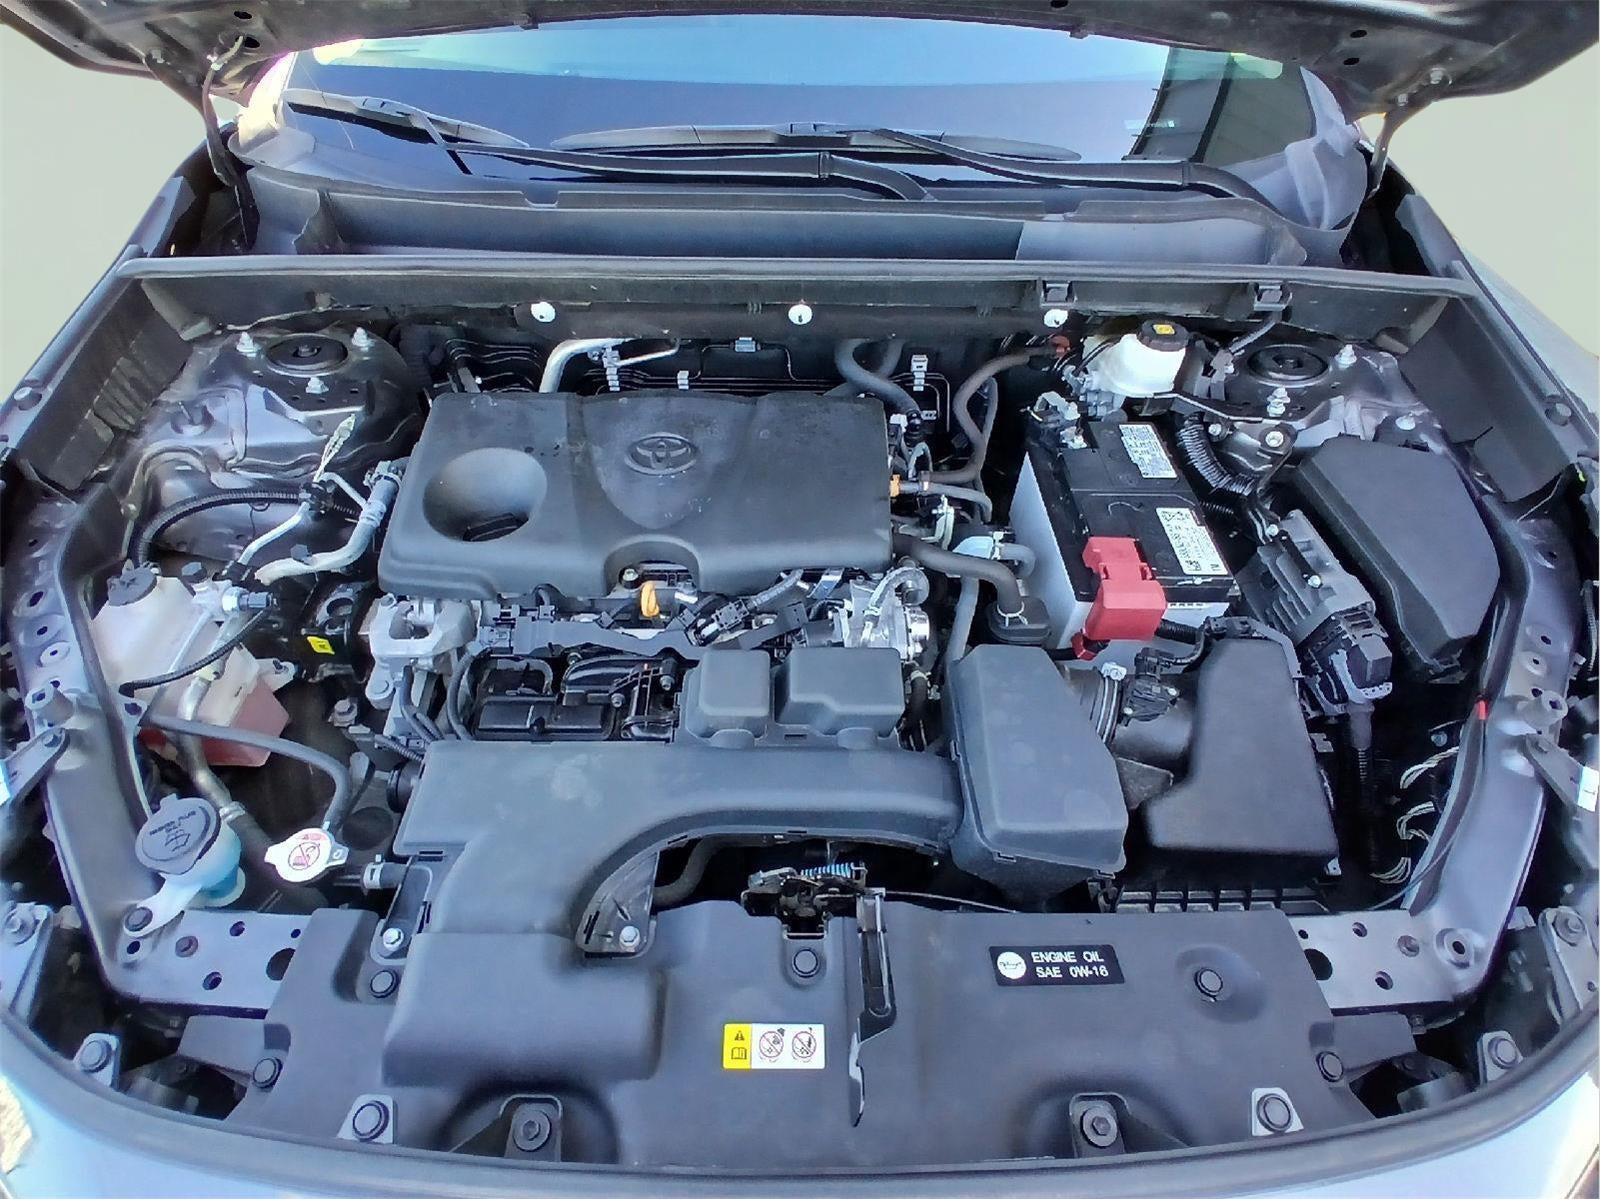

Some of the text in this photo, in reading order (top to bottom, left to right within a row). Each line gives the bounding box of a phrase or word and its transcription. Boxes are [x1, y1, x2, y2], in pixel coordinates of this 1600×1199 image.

[1031, 951, 1104, 963] ENGINE OIL
[1036, 965, 1109, 978] SAE 0W-16
